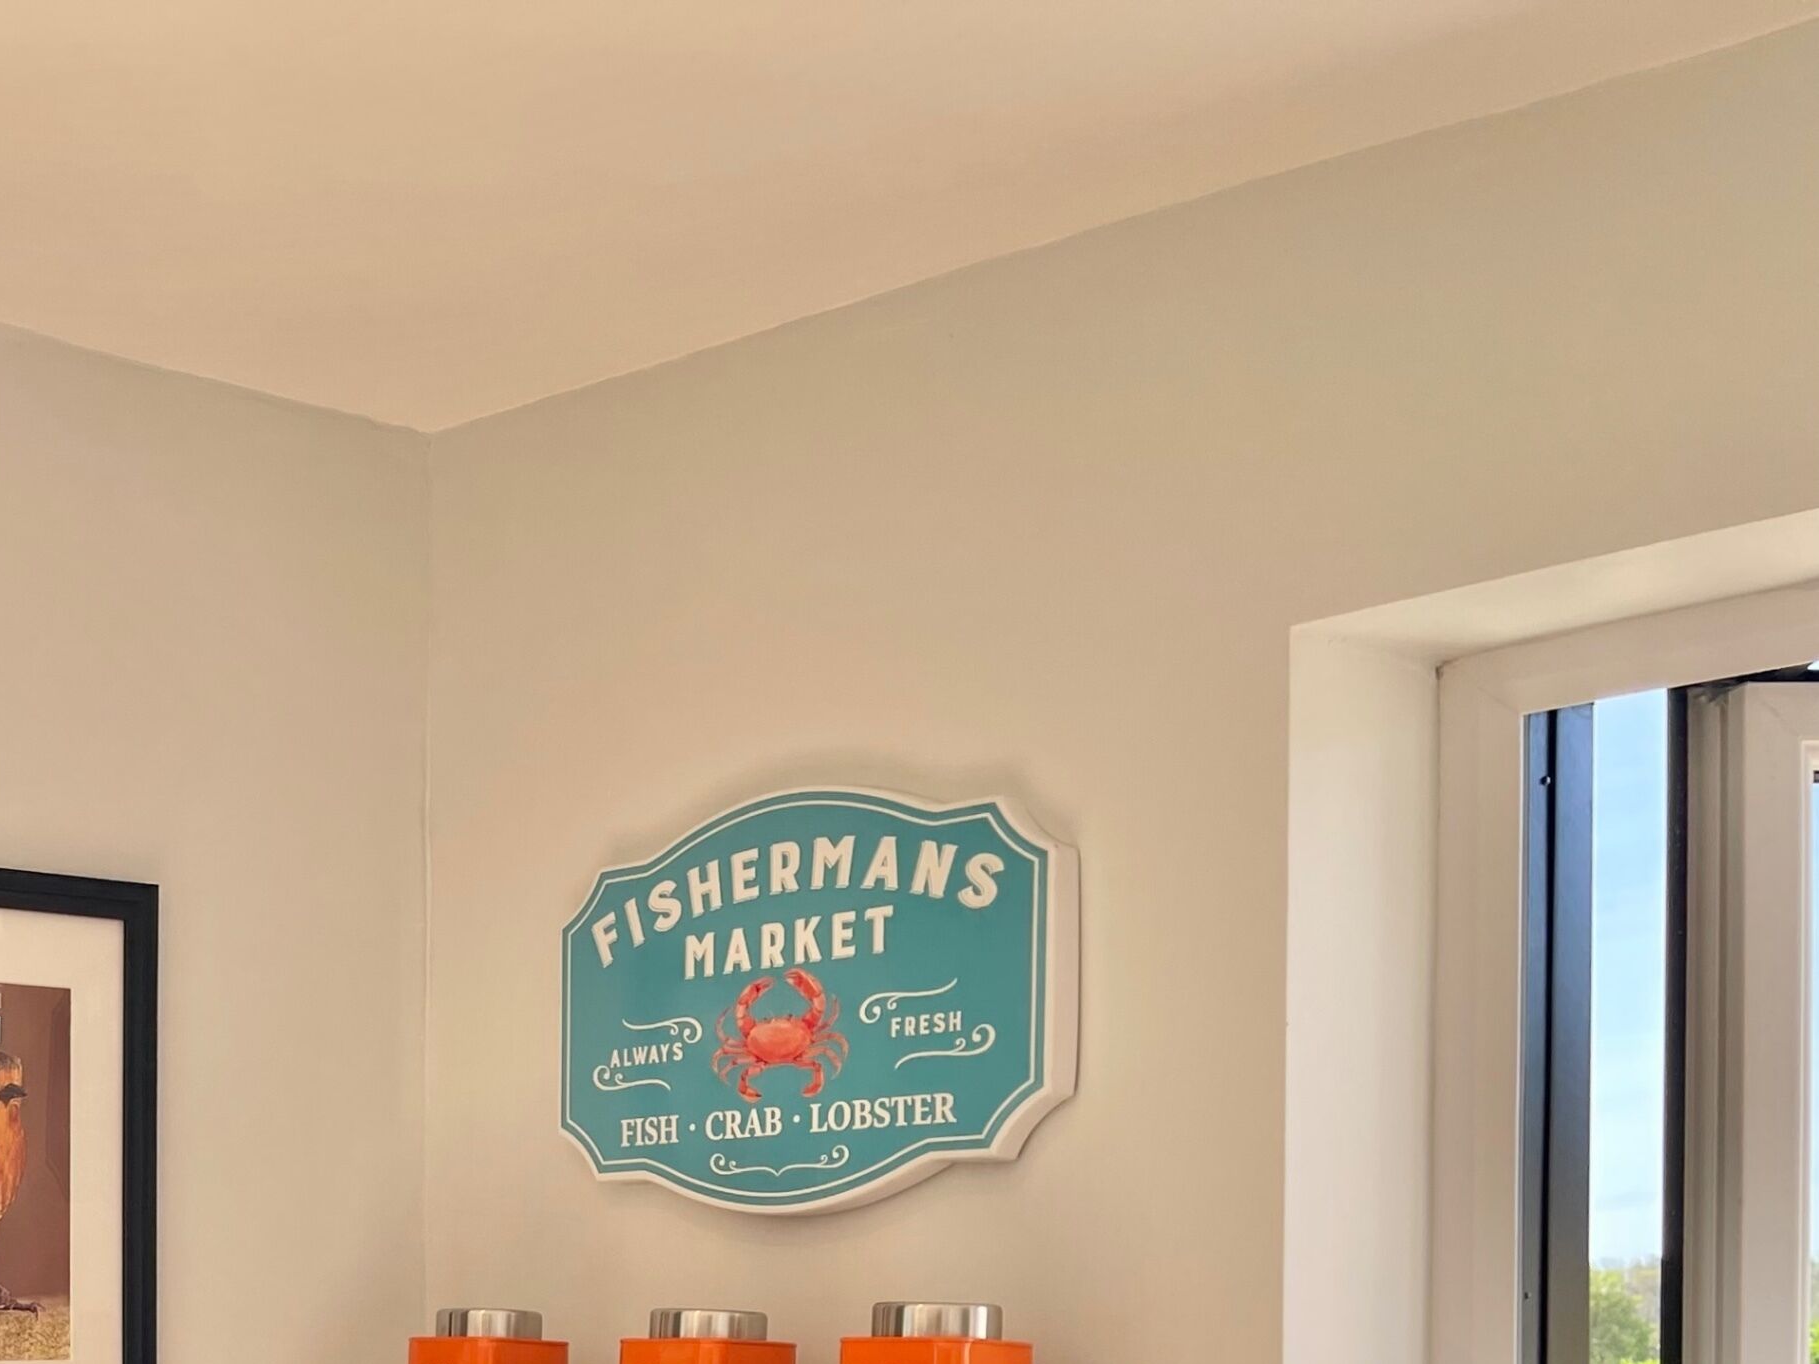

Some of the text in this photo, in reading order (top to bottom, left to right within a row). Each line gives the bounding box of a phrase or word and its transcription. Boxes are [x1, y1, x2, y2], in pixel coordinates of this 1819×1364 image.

[591, 836, 1005, 968] FISHERMANS
[684, 905, 894, 980] MARKET
[890, 1010, 962, 1038] FRESH
[610, 1041, 683, 1068] ALWAYS
[620, 1092, 956, 1147] FISH CRAB LOBSTER
